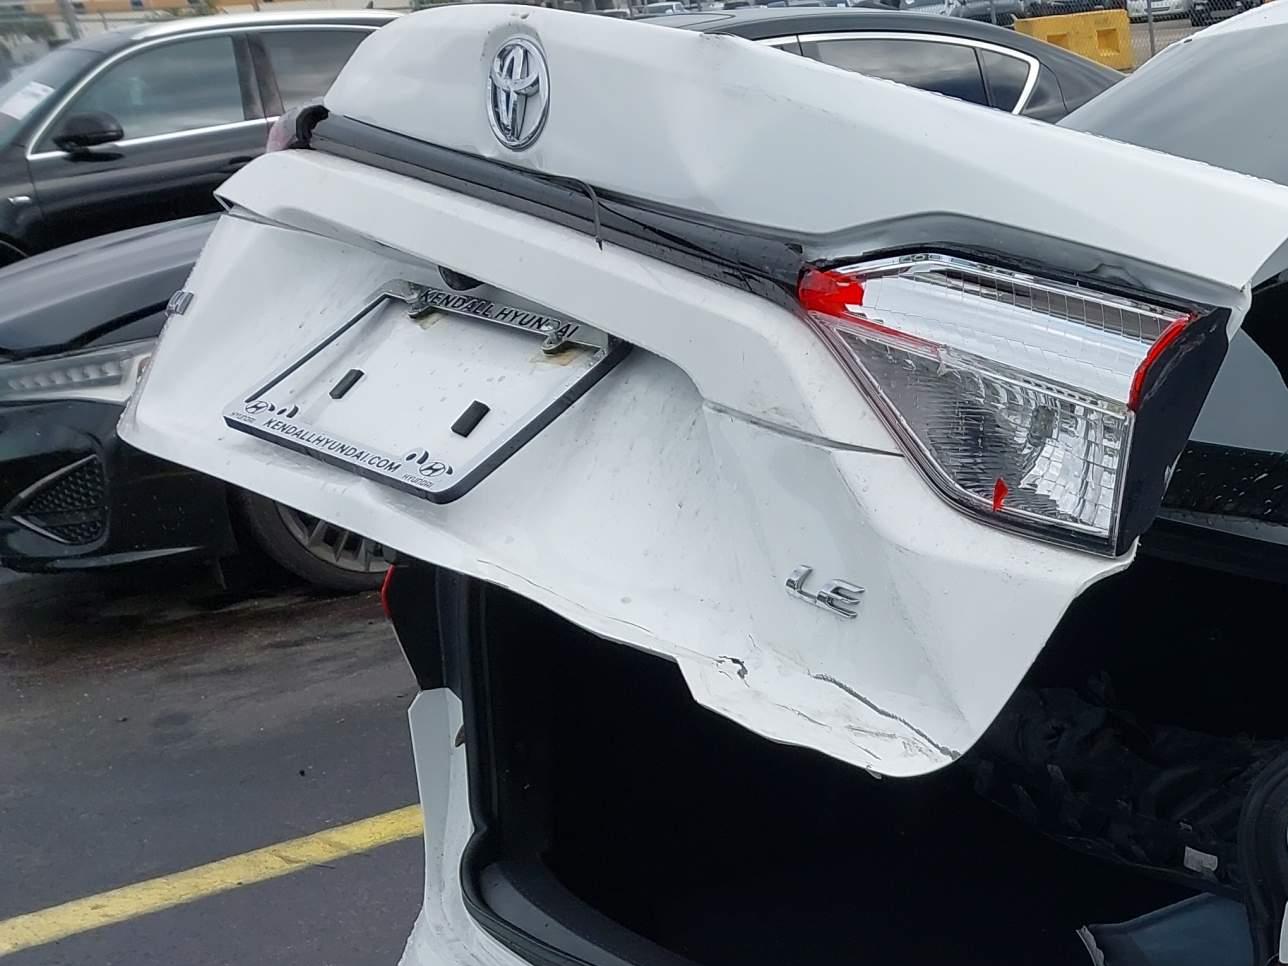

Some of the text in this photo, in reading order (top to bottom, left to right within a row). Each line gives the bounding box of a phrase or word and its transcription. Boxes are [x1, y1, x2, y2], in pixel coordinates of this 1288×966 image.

[420, 288, 495, 319] KENDALL
[263, 417, 401, 473] KENDALLHYUNDAI.COM
[785, 564, 865, 619] LE
